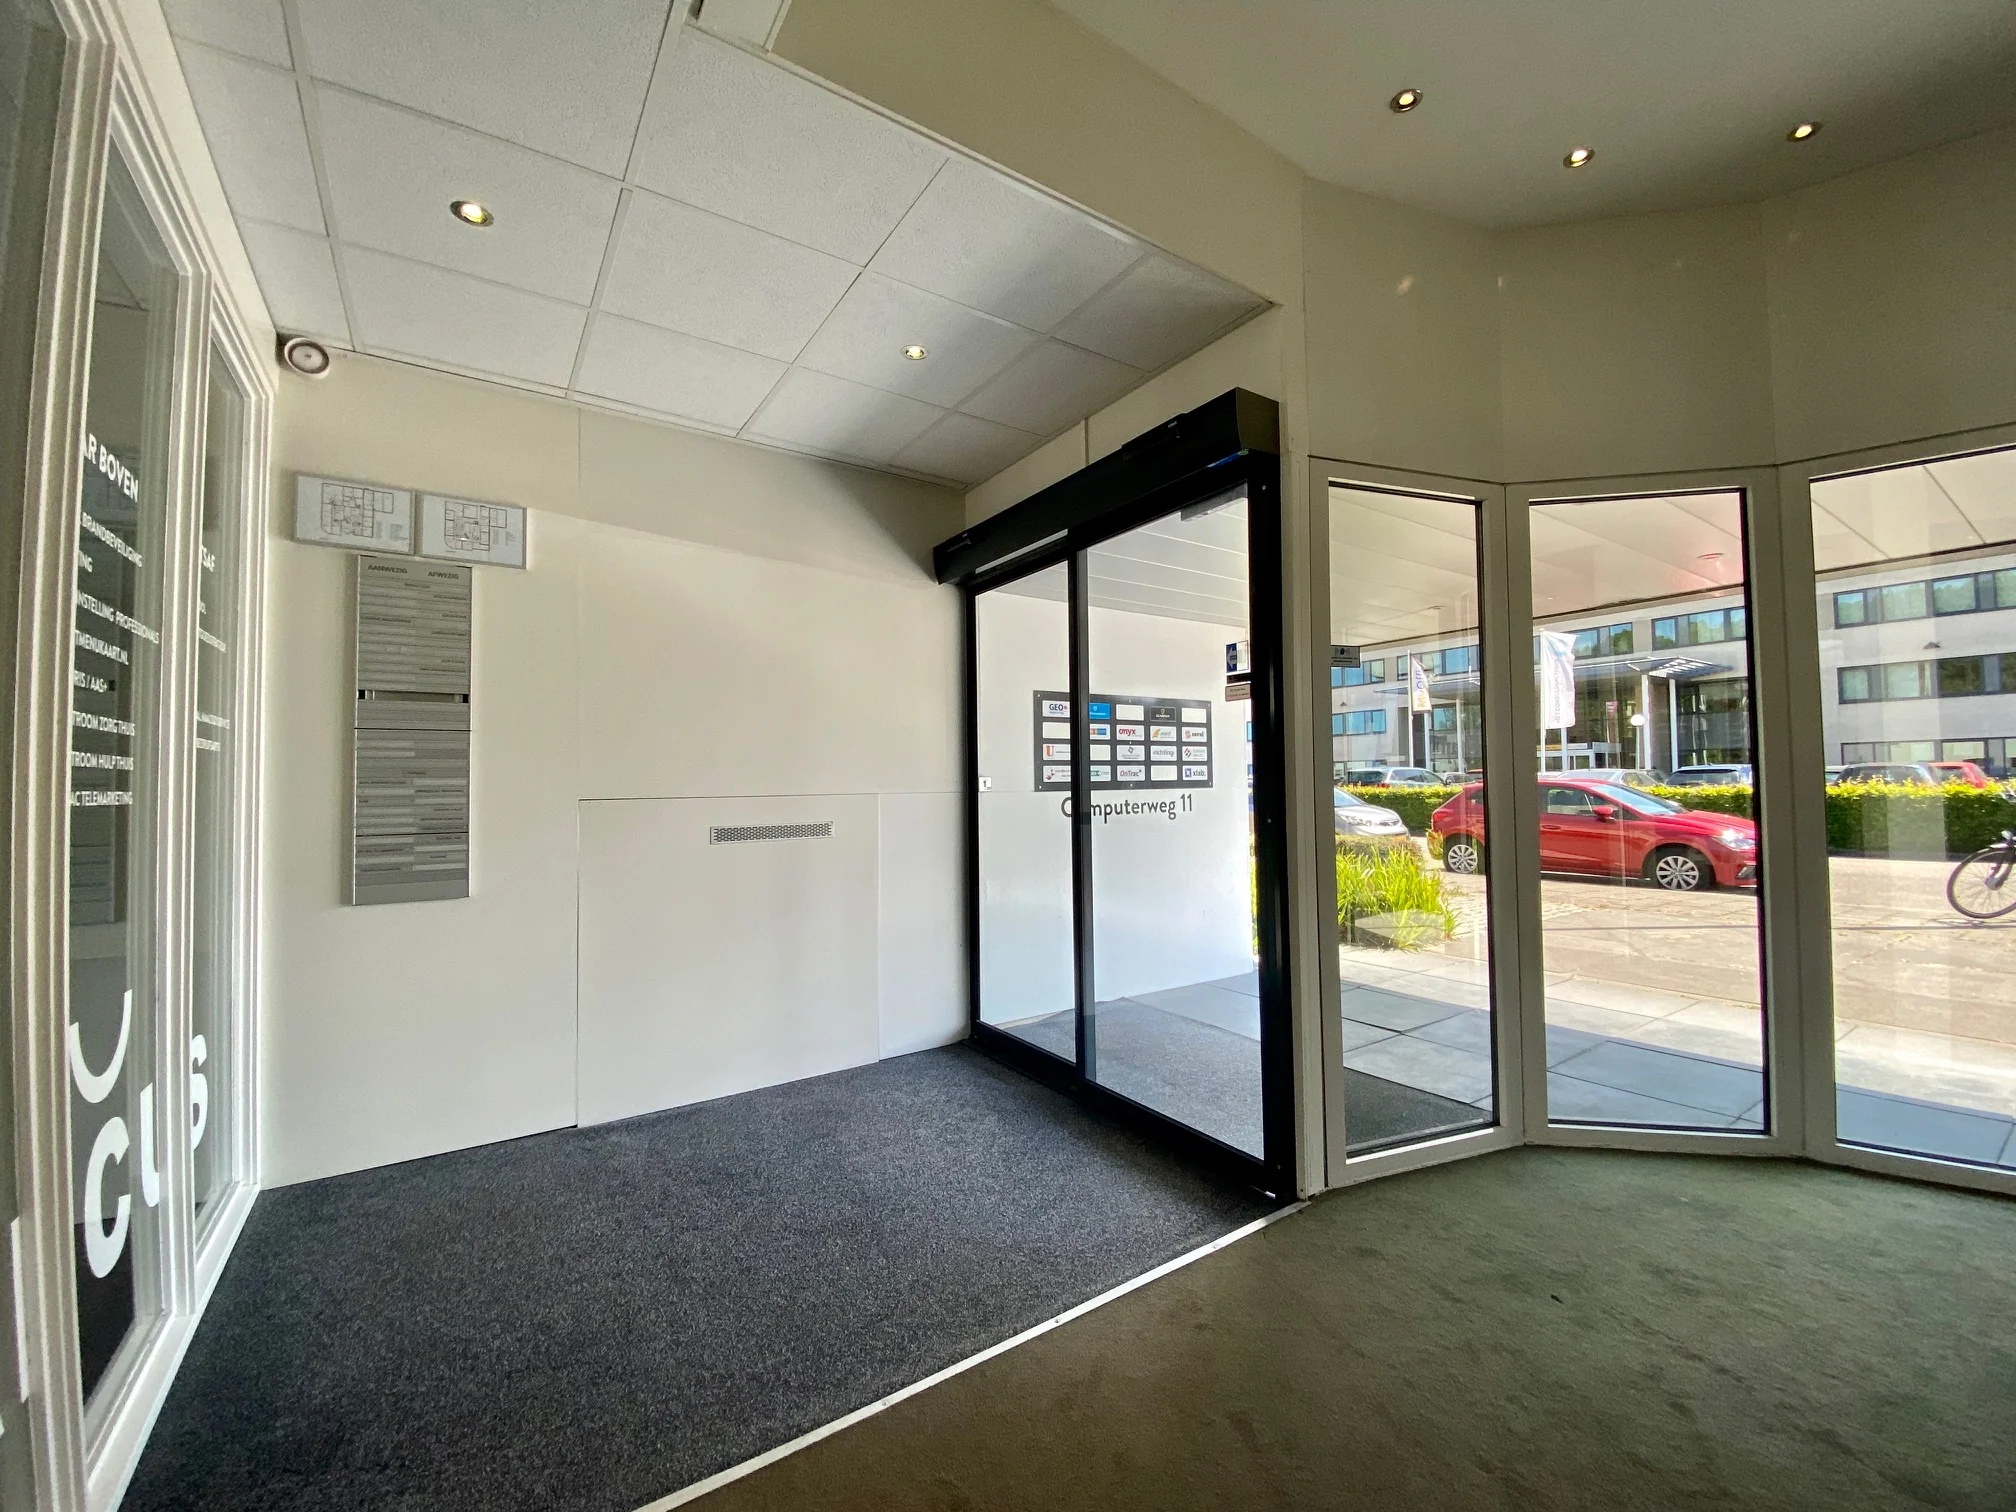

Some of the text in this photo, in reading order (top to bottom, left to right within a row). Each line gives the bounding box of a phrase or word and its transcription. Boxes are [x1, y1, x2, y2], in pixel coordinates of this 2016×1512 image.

[98, 443, 140, 503] BOVEN
[80, 789, 134, 806] TELEMARKETING
[1061, 793, 1193, 824] Cmputerweg 11
